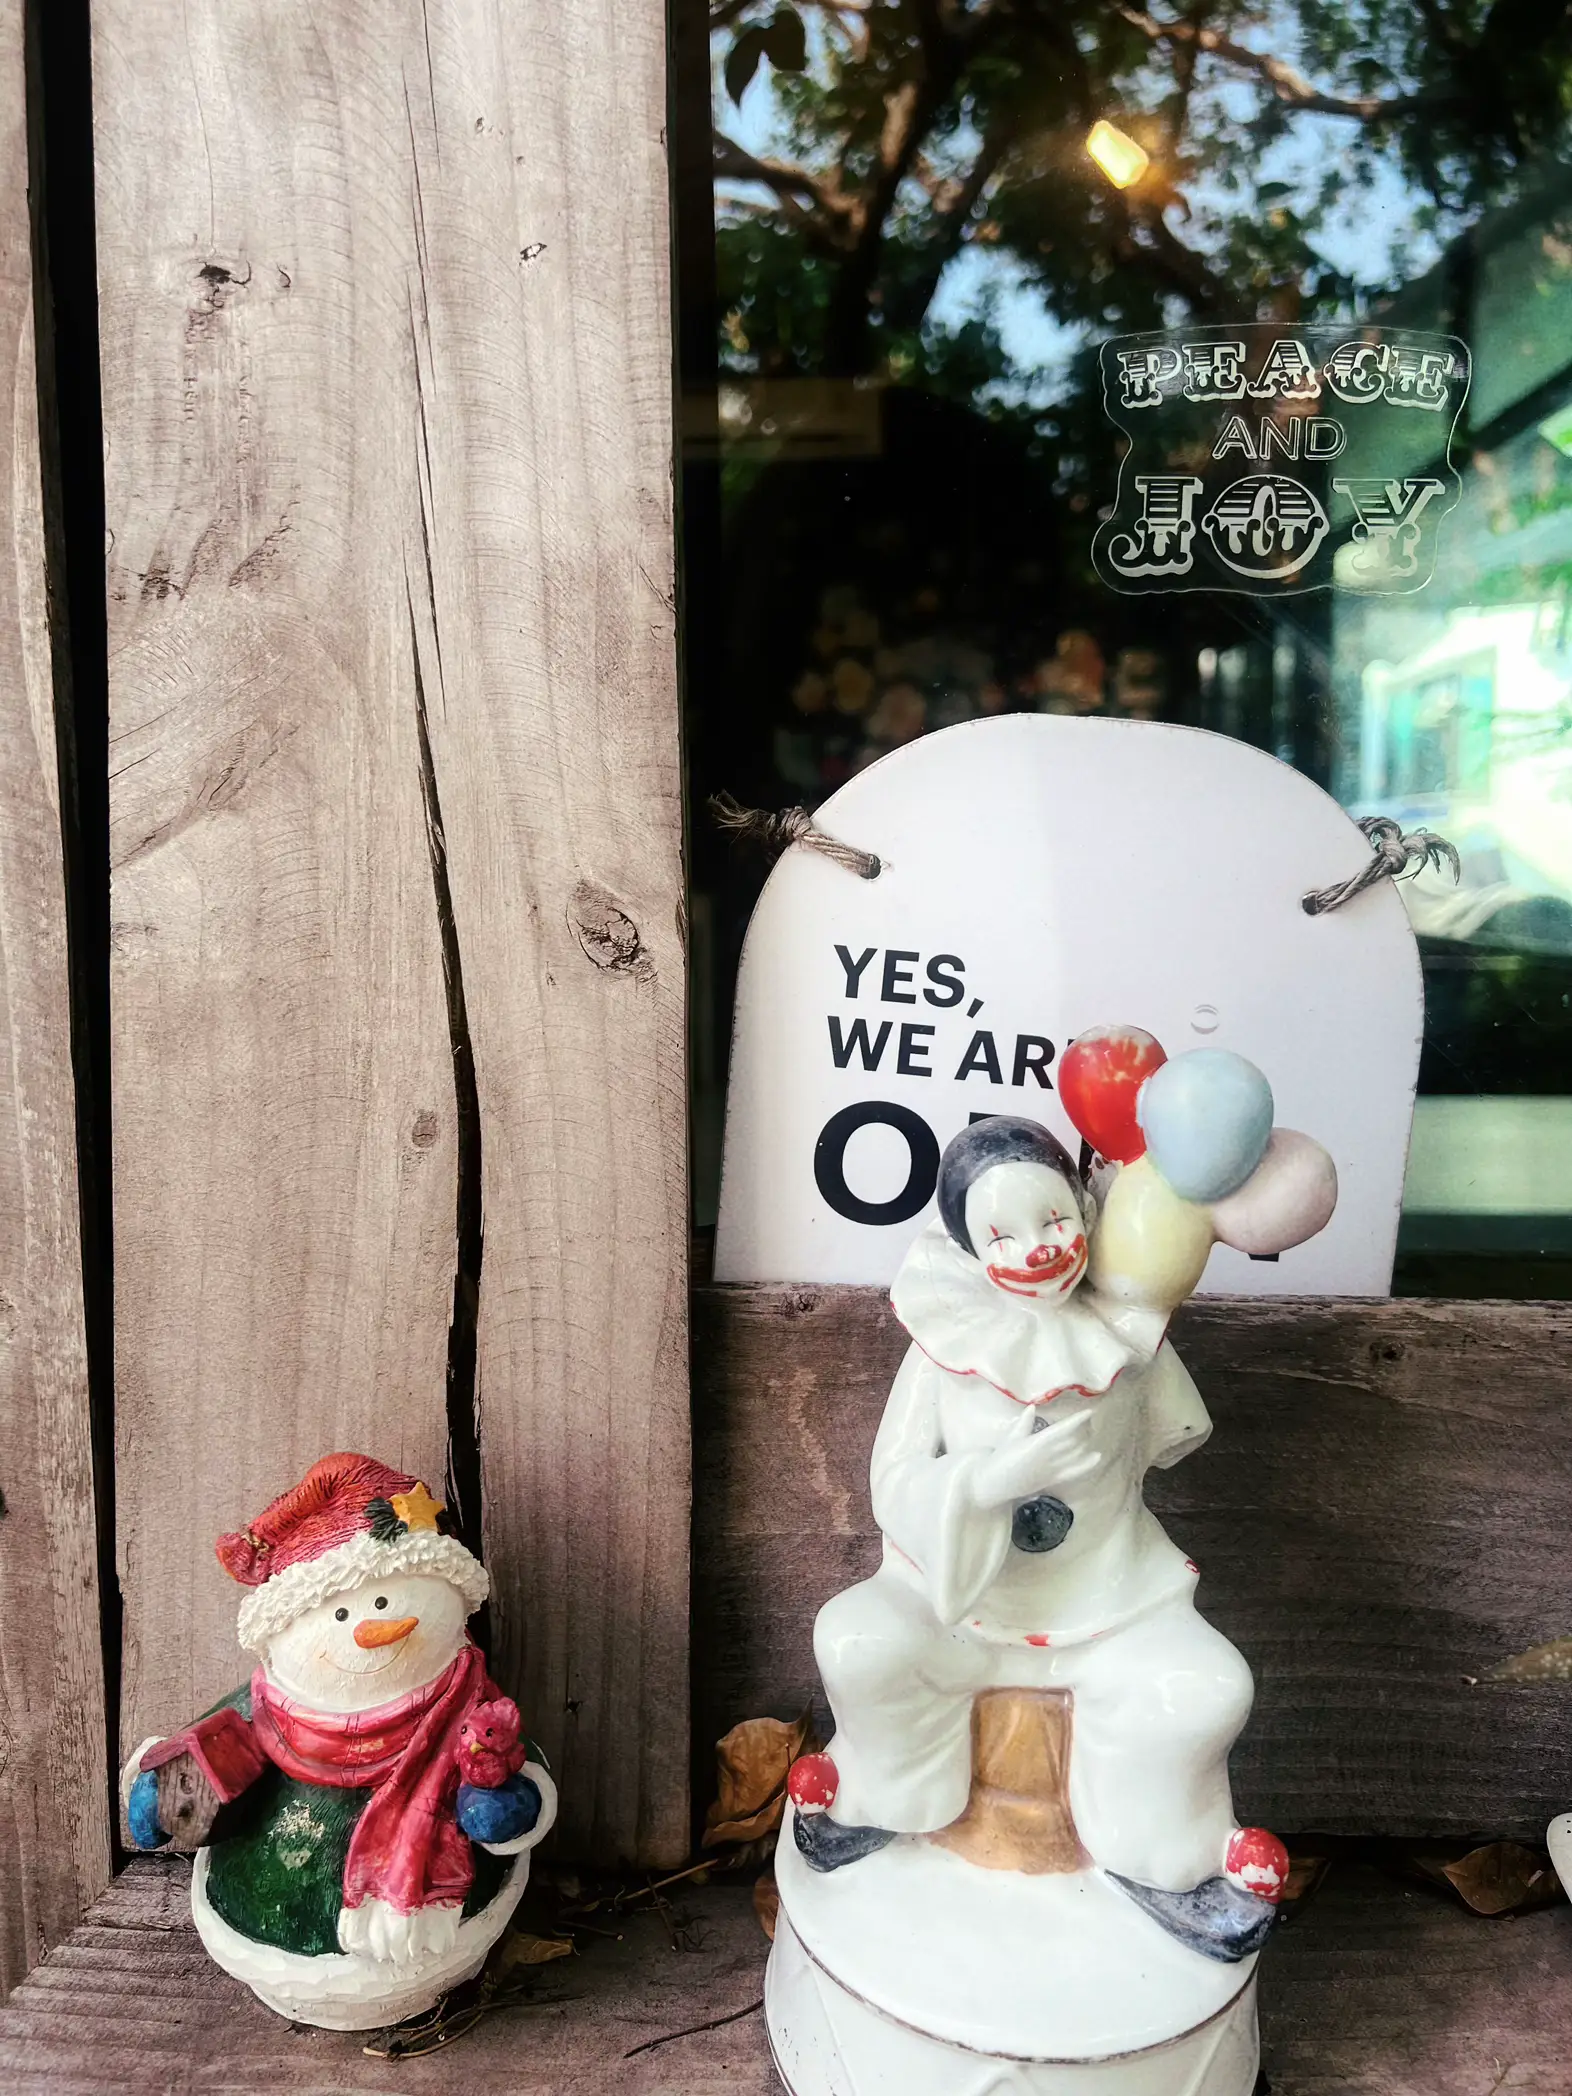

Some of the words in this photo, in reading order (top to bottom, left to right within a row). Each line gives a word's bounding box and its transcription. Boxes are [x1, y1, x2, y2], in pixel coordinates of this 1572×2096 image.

[1117, 340, 1455, 411] PEACE
[1212, 416, 1347, 460] AND
[1108, 474, 1445, 579] JOY
[833, 944, 984, 1018] YES,
[827, 1015, 935, 1077] WE
[954, 1030, 1075, 1090] AR
